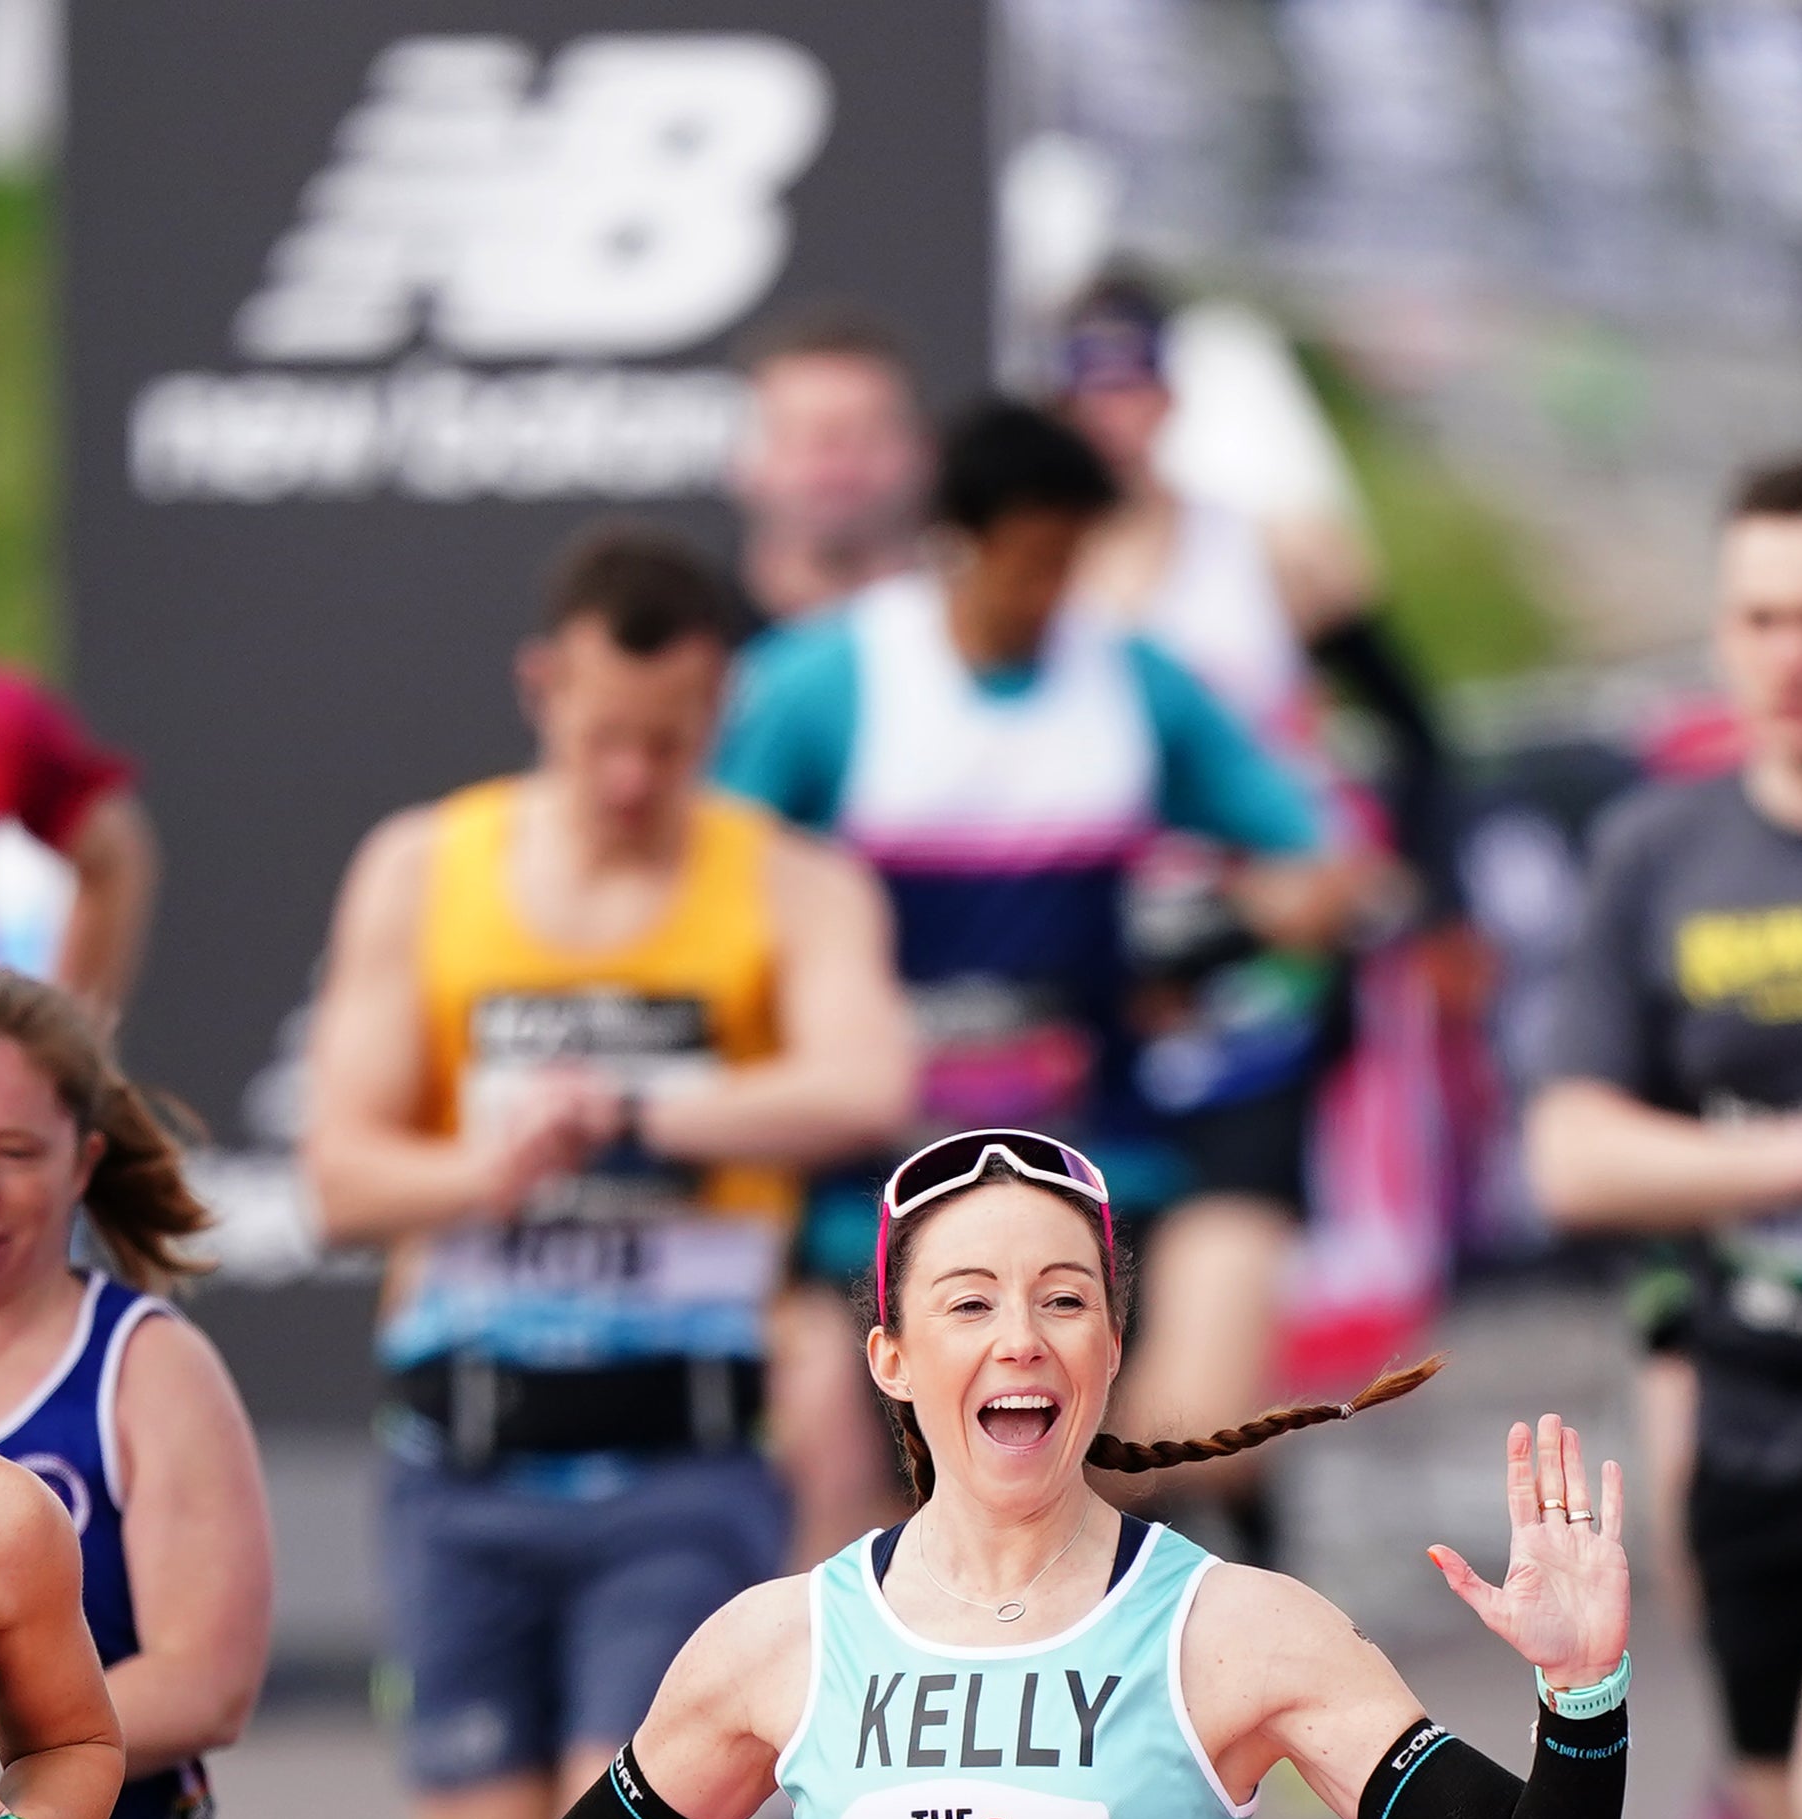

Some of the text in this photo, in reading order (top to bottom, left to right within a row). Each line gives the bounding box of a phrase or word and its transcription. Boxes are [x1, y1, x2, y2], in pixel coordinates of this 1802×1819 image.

[127, 368, 742, 502] new balan
[855, 1670, 1121, 1769] KELLY
